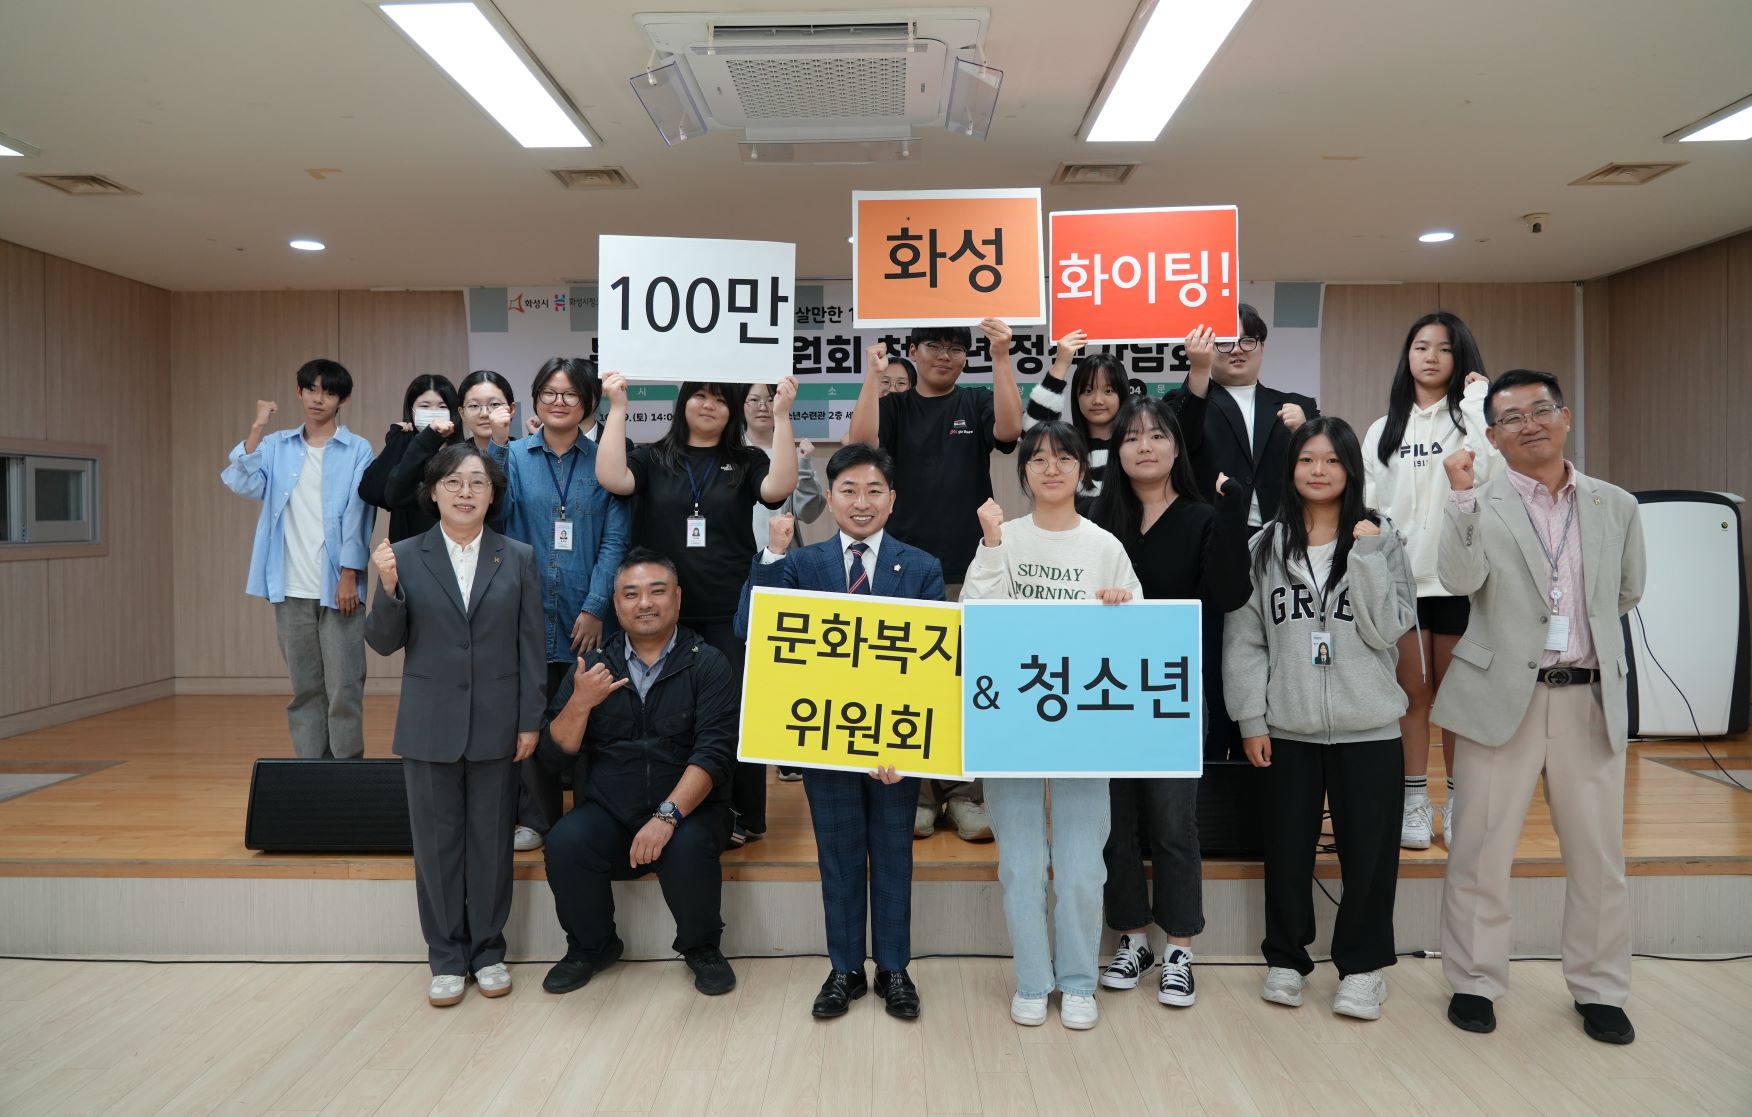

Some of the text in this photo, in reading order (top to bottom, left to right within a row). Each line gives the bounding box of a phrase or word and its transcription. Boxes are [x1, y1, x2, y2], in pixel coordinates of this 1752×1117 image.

[884, 227, 1004, 292] 화성
[1058, 251, 1231, 308] 화이팅!
[525, 299, 549, 309] 화성시
[611, 277, 789, 344] 100만
[795, 306, 843, 324] 살만한
[827, 386, 837, 396] 소
[828, 411, 843, 420] 2층
[1400, 441, 1443, 459] FILA
[1017, 563, 1085, 582] SUNDAY
[766, 611, 961, 677] 문화복지
[972, 654, 1191, 723] & 청소년
[785, 698, 934, 760] 위원회
